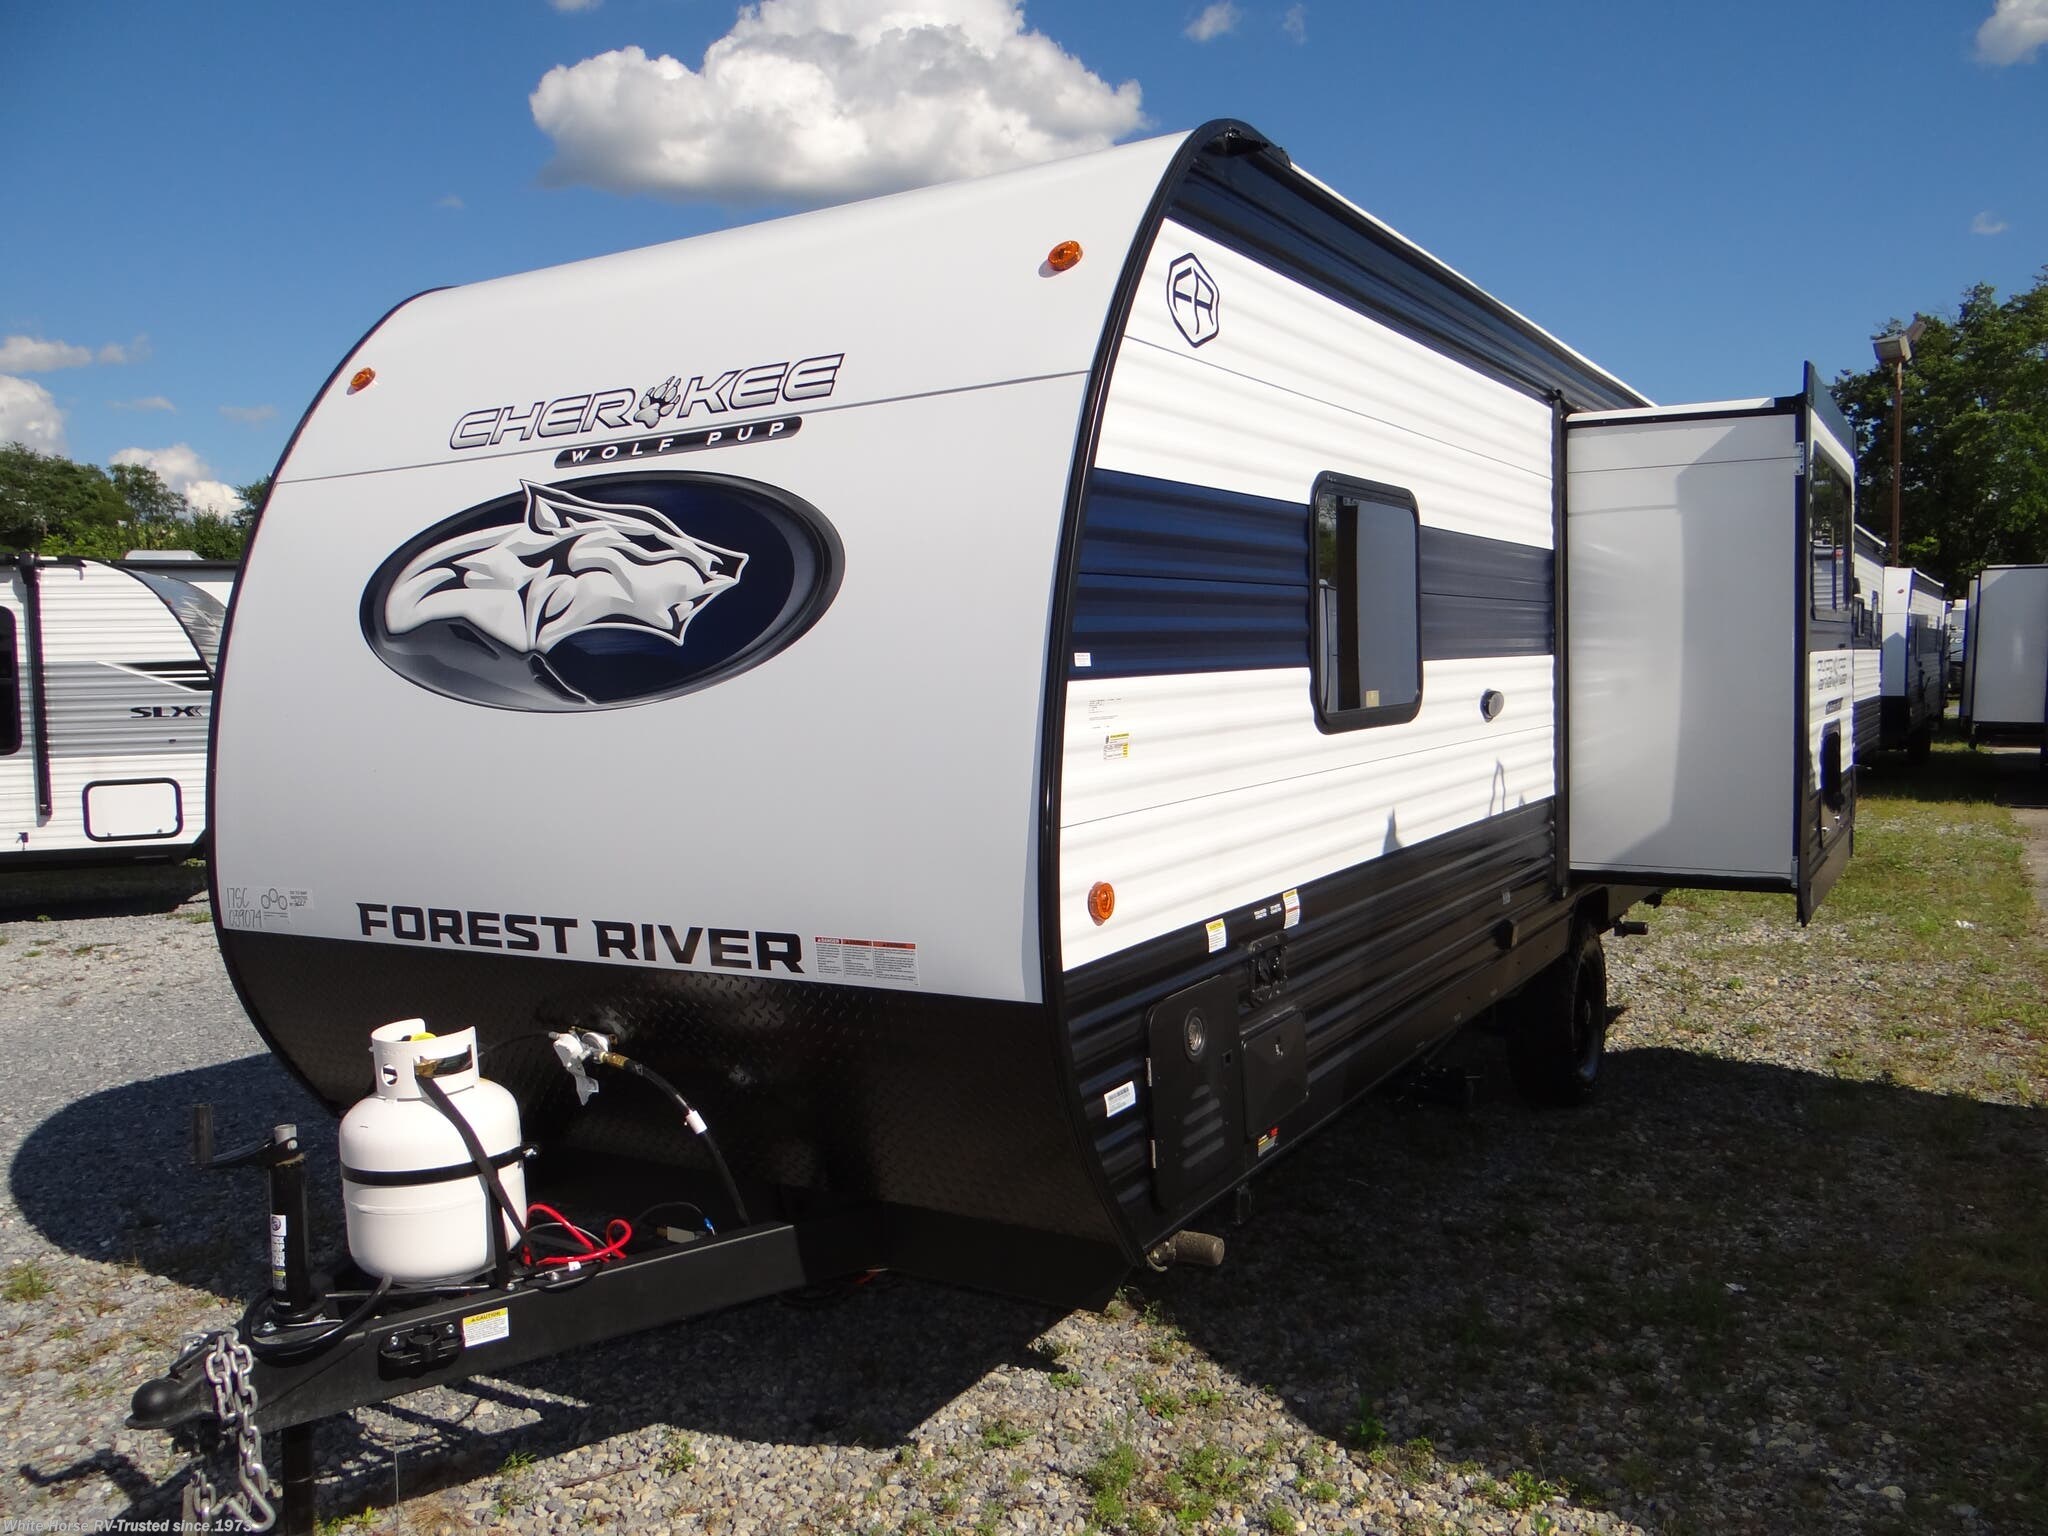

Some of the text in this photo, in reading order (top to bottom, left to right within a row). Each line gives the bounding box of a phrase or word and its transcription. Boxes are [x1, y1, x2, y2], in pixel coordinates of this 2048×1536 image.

[571, 420, 786, 463] WOLF PUP
[355, 902, 578, 954] FOREST
[591, 920, 805, 974] RIVER
[476, 1311, 501, 1321] CAUTION
